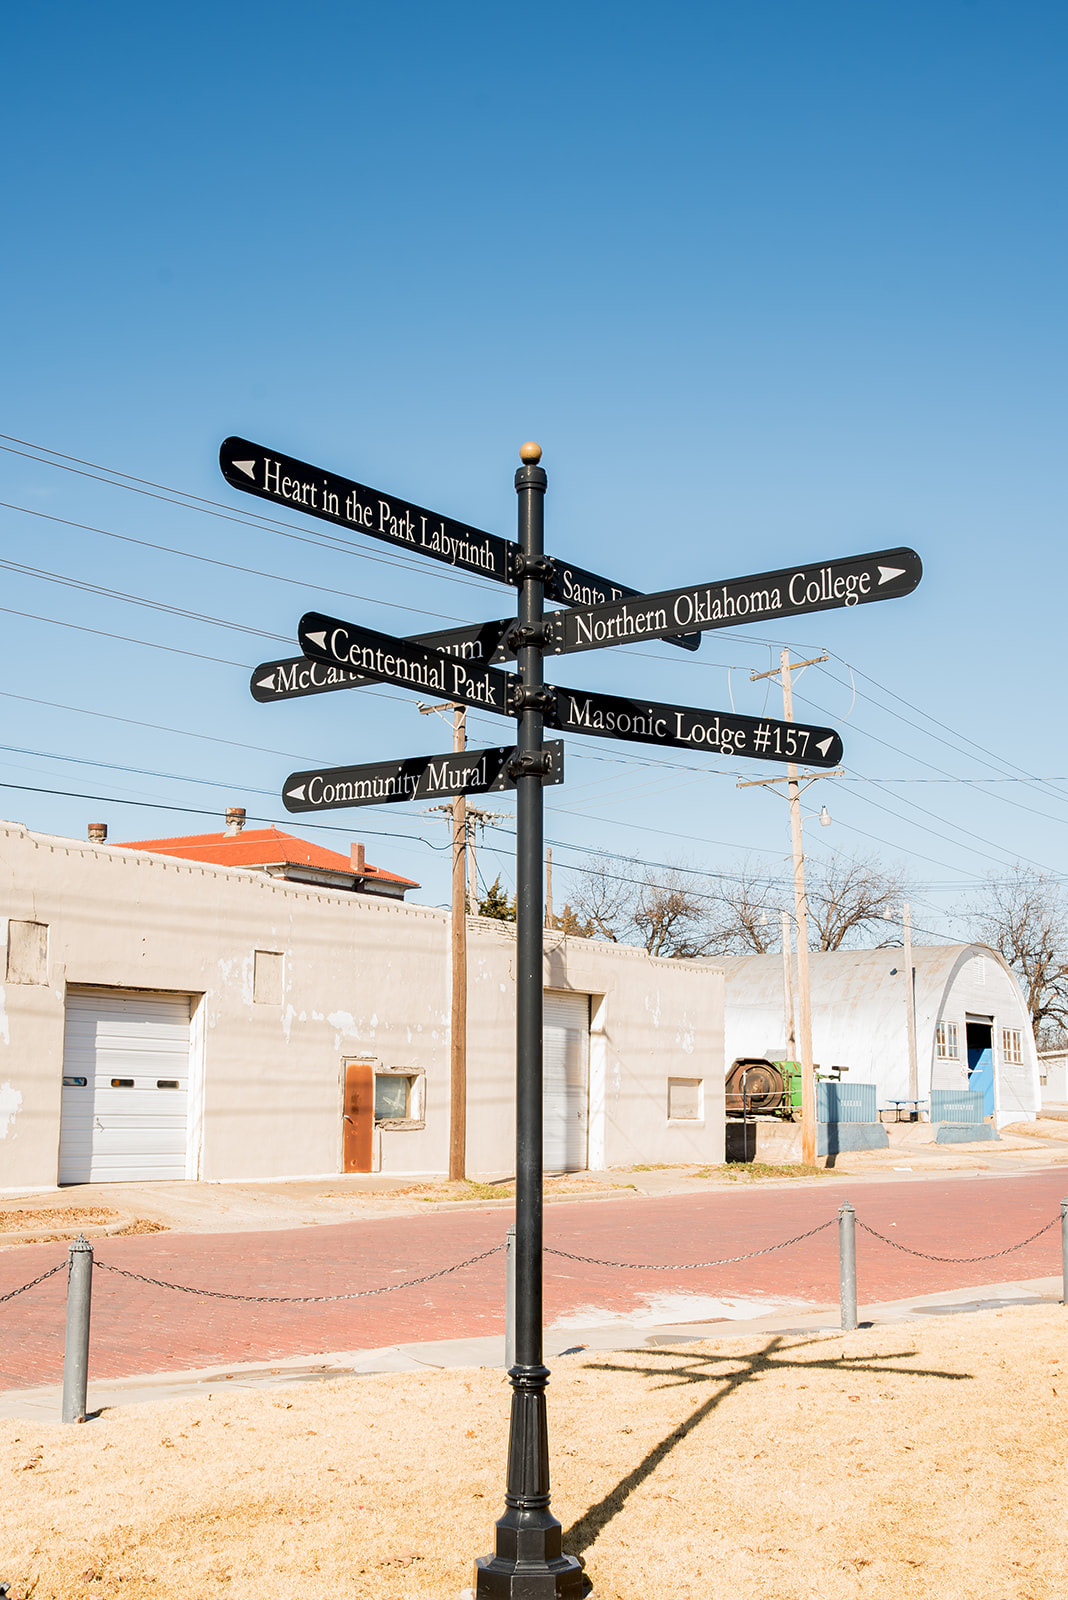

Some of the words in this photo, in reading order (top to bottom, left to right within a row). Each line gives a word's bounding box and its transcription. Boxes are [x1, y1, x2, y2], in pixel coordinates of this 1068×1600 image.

[263, 458, 317, 506] Heart
[322, 480, 340, 516] in
[345, 491, 373, 526] the
[378, 501, 416, 542] Park
[420, 516, 496, 571] Labyrinth
[575, 606, 668, 645] Northern
[673, 587, 782, 626] Oklahoma
[789, 568, 870, 607] College
[331, 629, 446, 690] Centennial
[452, 664, 496, 705] Park
[567, 696, 666, 737] Masonic
[675, 713, 746, 755] Lodge
[753, 724, 810, 757] #157
[308, 767, 421, 801] Community
[426, 757, 487, 791] Mural
